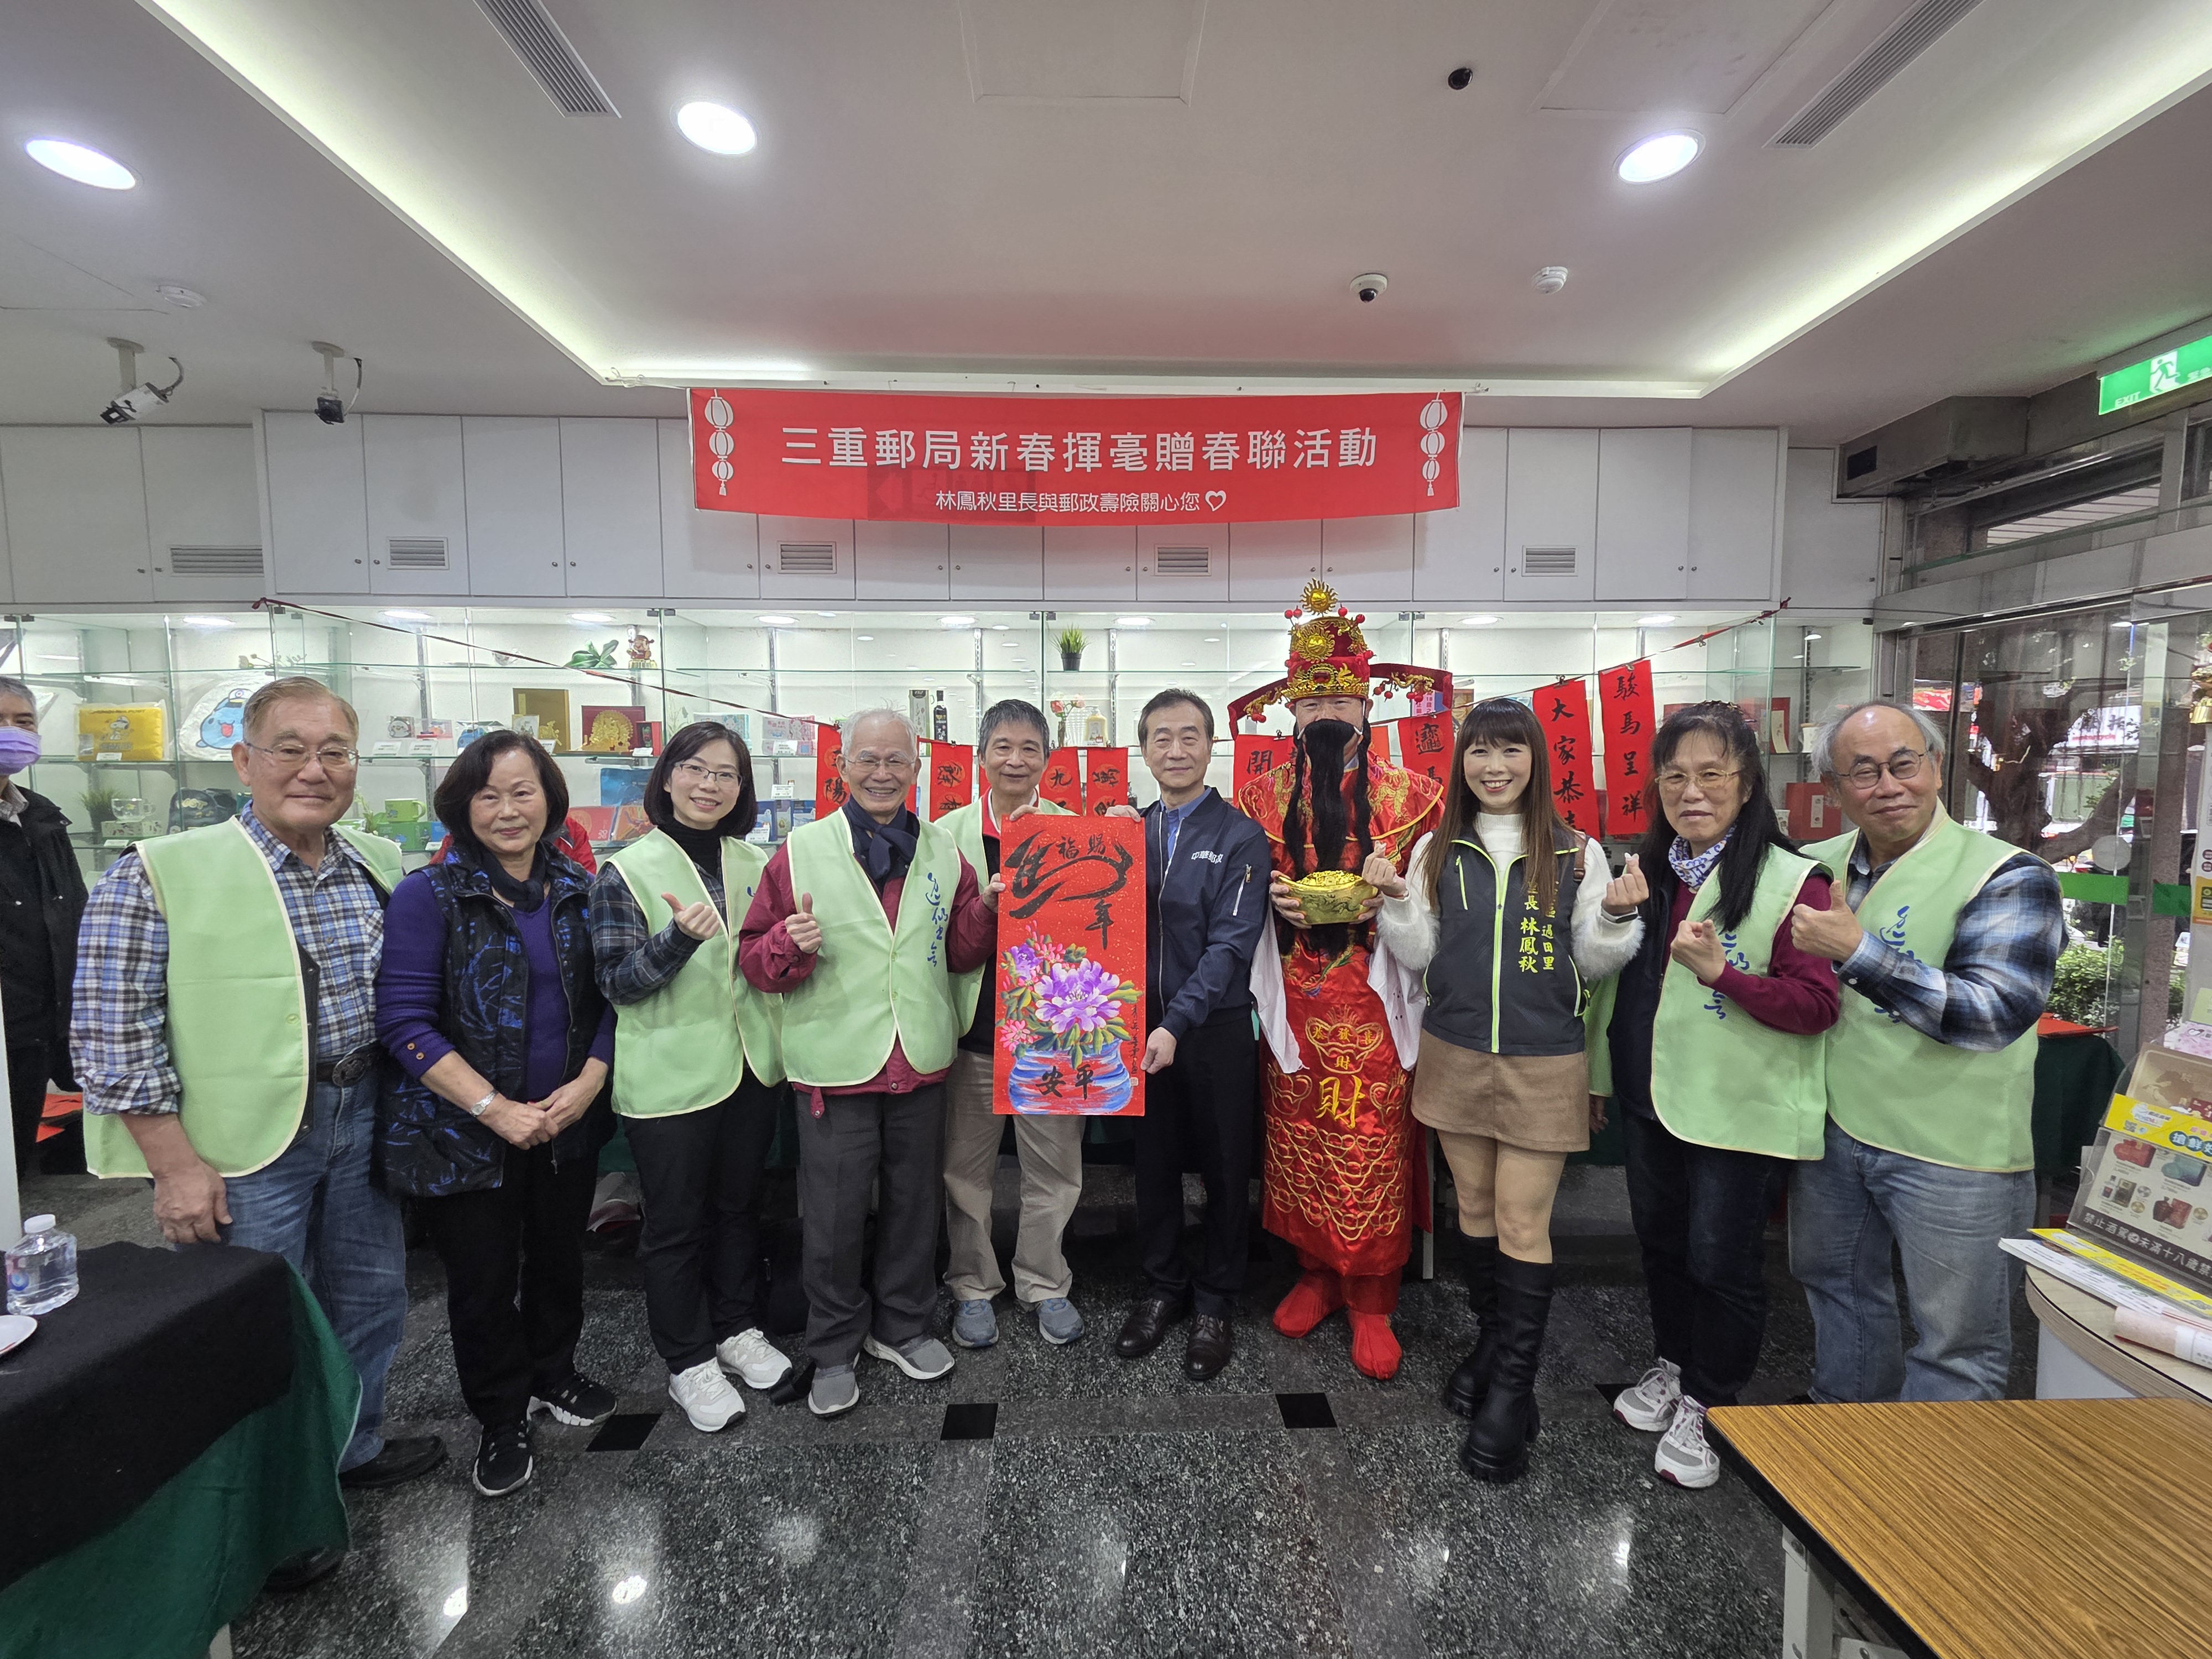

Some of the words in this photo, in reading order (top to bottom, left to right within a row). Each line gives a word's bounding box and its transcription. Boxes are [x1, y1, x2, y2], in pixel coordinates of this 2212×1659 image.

[2115, 391, 2141, 408] EXIT
[781, 426, 1376, 472] 三重郵局新春揮毫贈春聯活動
[936, 490, 1199, 513] 林鳳秋里長與郵政壽險關心您
[1614, 672, 1643, 822] 駿馬呈祥
[2083, 1212, 2130, 1240] 禁止酒駕
[2138, 1237, 2212, 1279] 未滿十八歲禁
